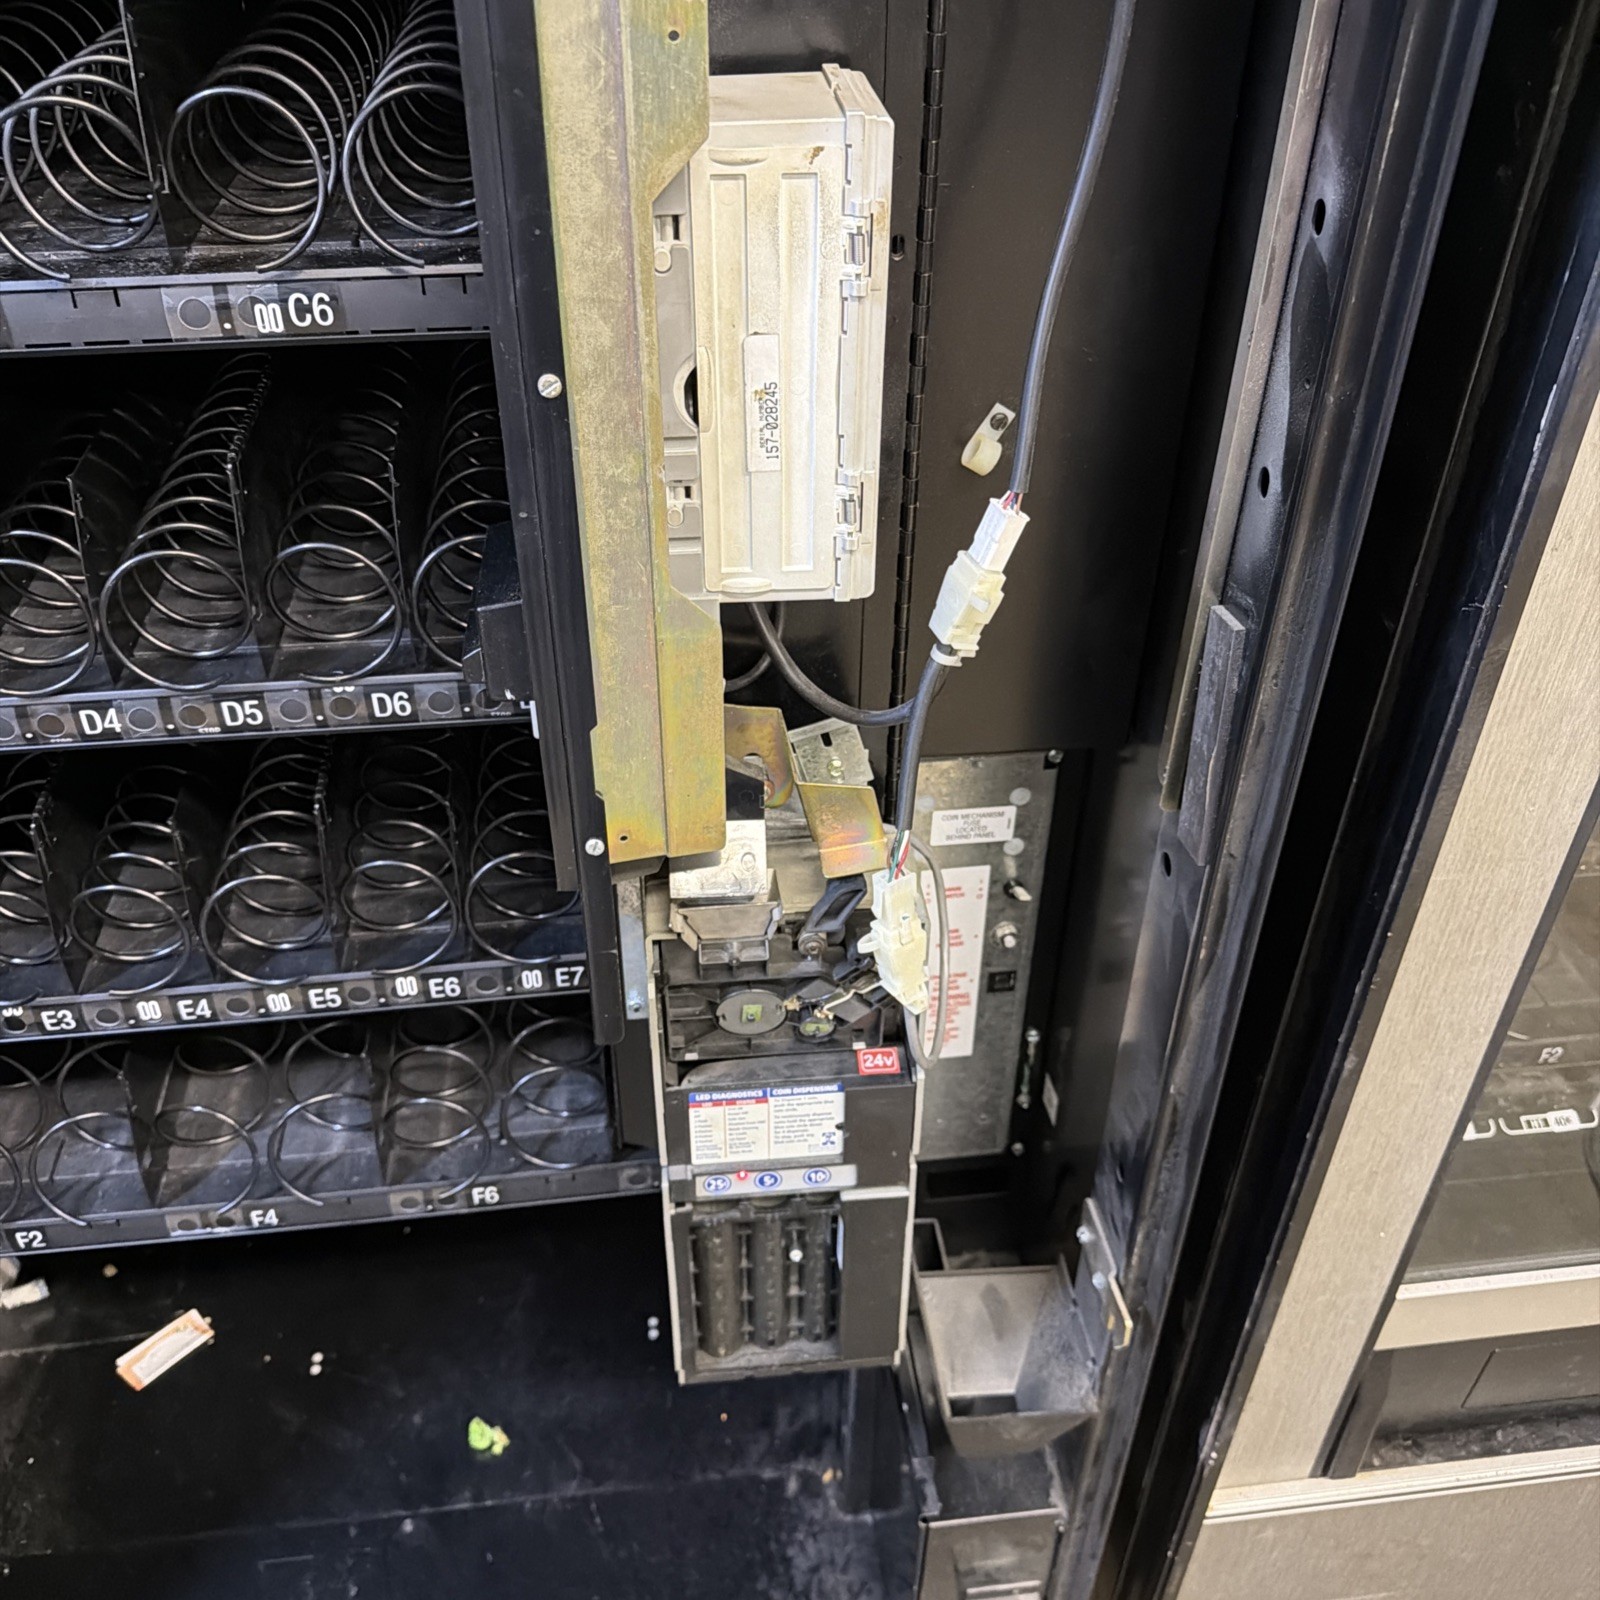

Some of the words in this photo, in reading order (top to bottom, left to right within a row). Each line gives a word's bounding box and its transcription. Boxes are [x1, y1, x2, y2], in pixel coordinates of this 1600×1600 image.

[288, 292, 334, 327] C6
[764, 382, 779, 460] 157-028245
[220, 700, 264, 727] D5
[370, 691, 412, 718] D6
[78, 708, 122, 735] D4
[961, 811, 1005, 820] MECHANISM
[956, 826, 987, 834] LOCATED
[555, 966, 585, 988] E7
[308, 988, 342, 1009] E5
[428, 977, 461, 999] E6
[41, 1009, 76, 1031] E3
[177, 998, 212, 1021] E4
[1538, 1046, 1564, 1064] F2
[695, 1093, 711, 1102] LED
[712, 1090, 763, 1100] DIAGNOSTICS
[772, 1088, 792, 1096] COIN
[792, 1085, 838, 1094] DISPENSING
[471, 1186, 500, 1206] F6
[250, 1209, 279, 1228] F4
[15, 1230, 47, 1249] F2
